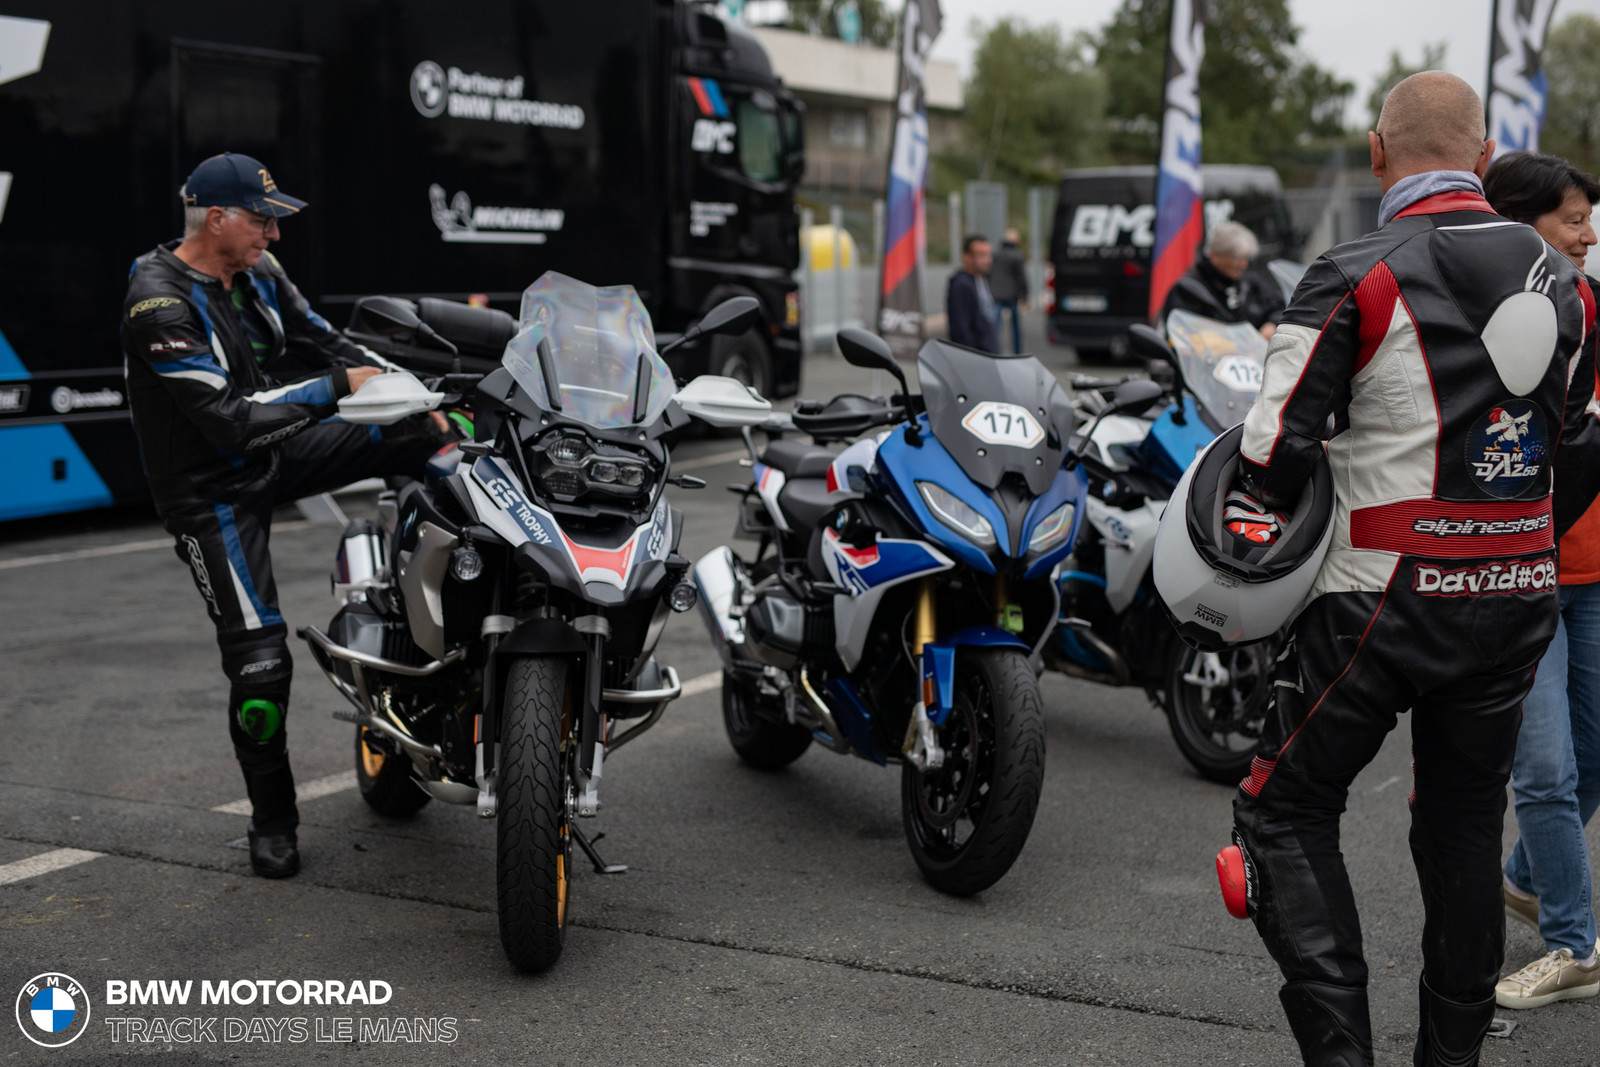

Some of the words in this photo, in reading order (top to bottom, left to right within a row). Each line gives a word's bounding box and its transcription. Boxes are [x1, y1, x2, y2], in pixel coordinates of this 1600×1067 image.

[448, 92, 493, 121] BMW
[984, 411, 1028, 438] 171
[486, 477, 521, 508] GS
[516, 503, 552, 545] TROPHY
[1414, 513, 1549, 535] alpinestars
[1415, 560, 1557, 593] David#02
[1194, 610, 1225, 628] BMW
